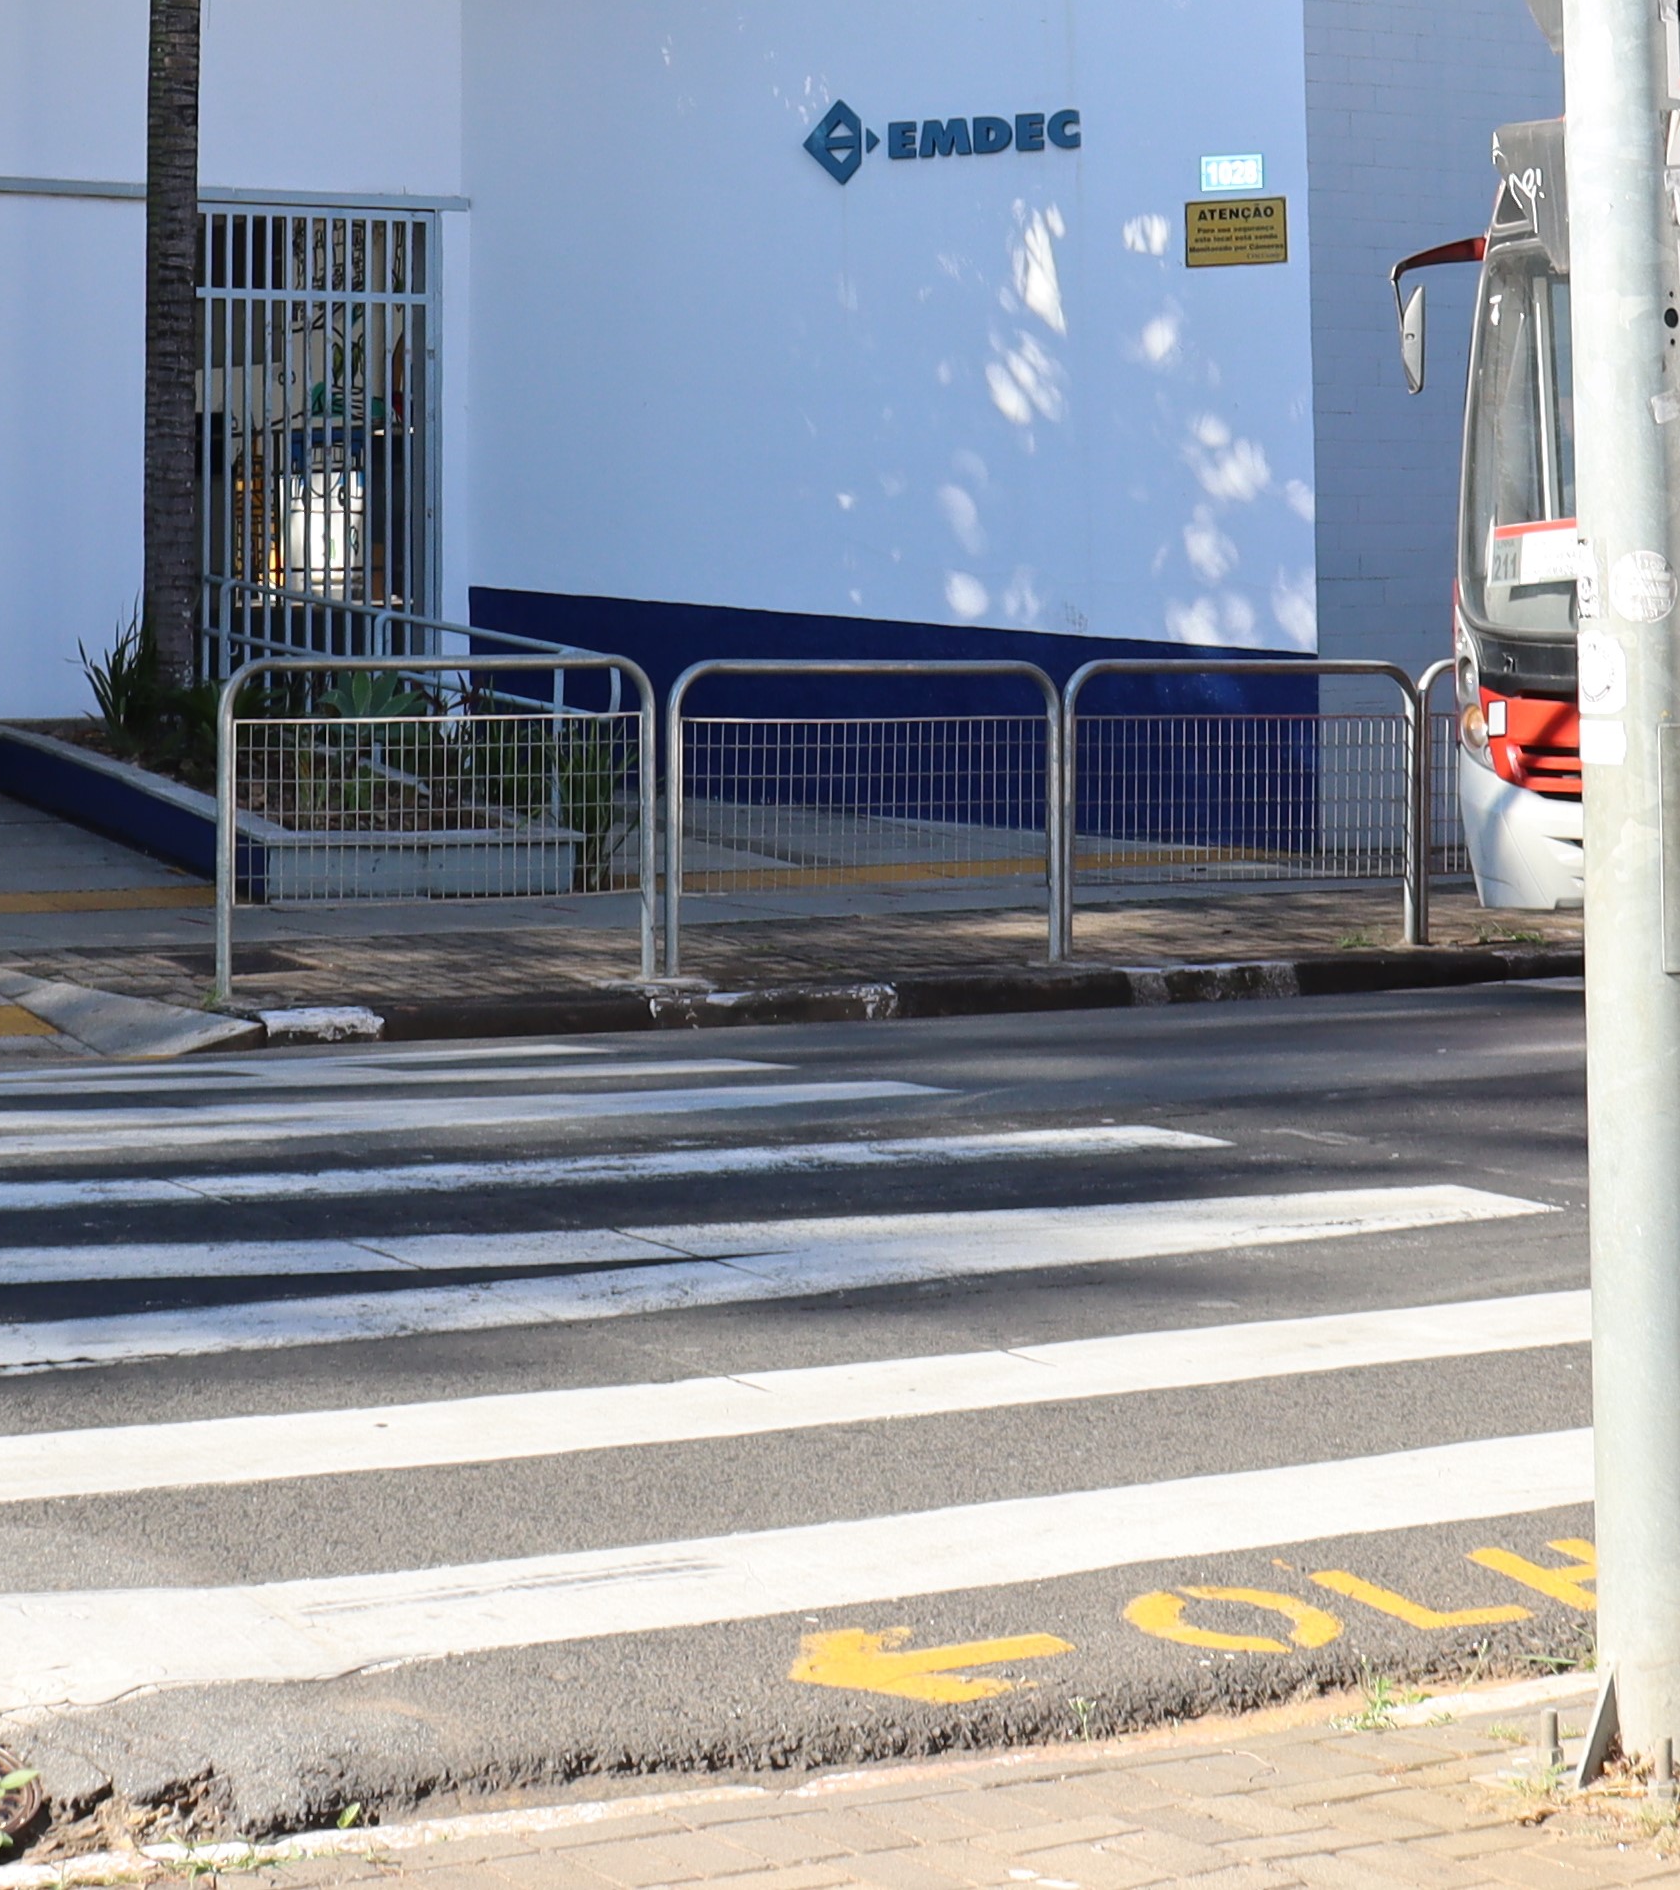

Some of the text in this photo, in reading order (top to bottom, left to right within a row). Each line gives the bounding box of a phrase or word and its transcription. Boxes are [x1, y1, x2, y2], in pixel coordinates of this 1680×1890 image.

[887, 109, 1082, 159] EMDEC
[1197, 203, 1275, 222] ATENÇÃO
[1493, 551, 1517, 581] 211
